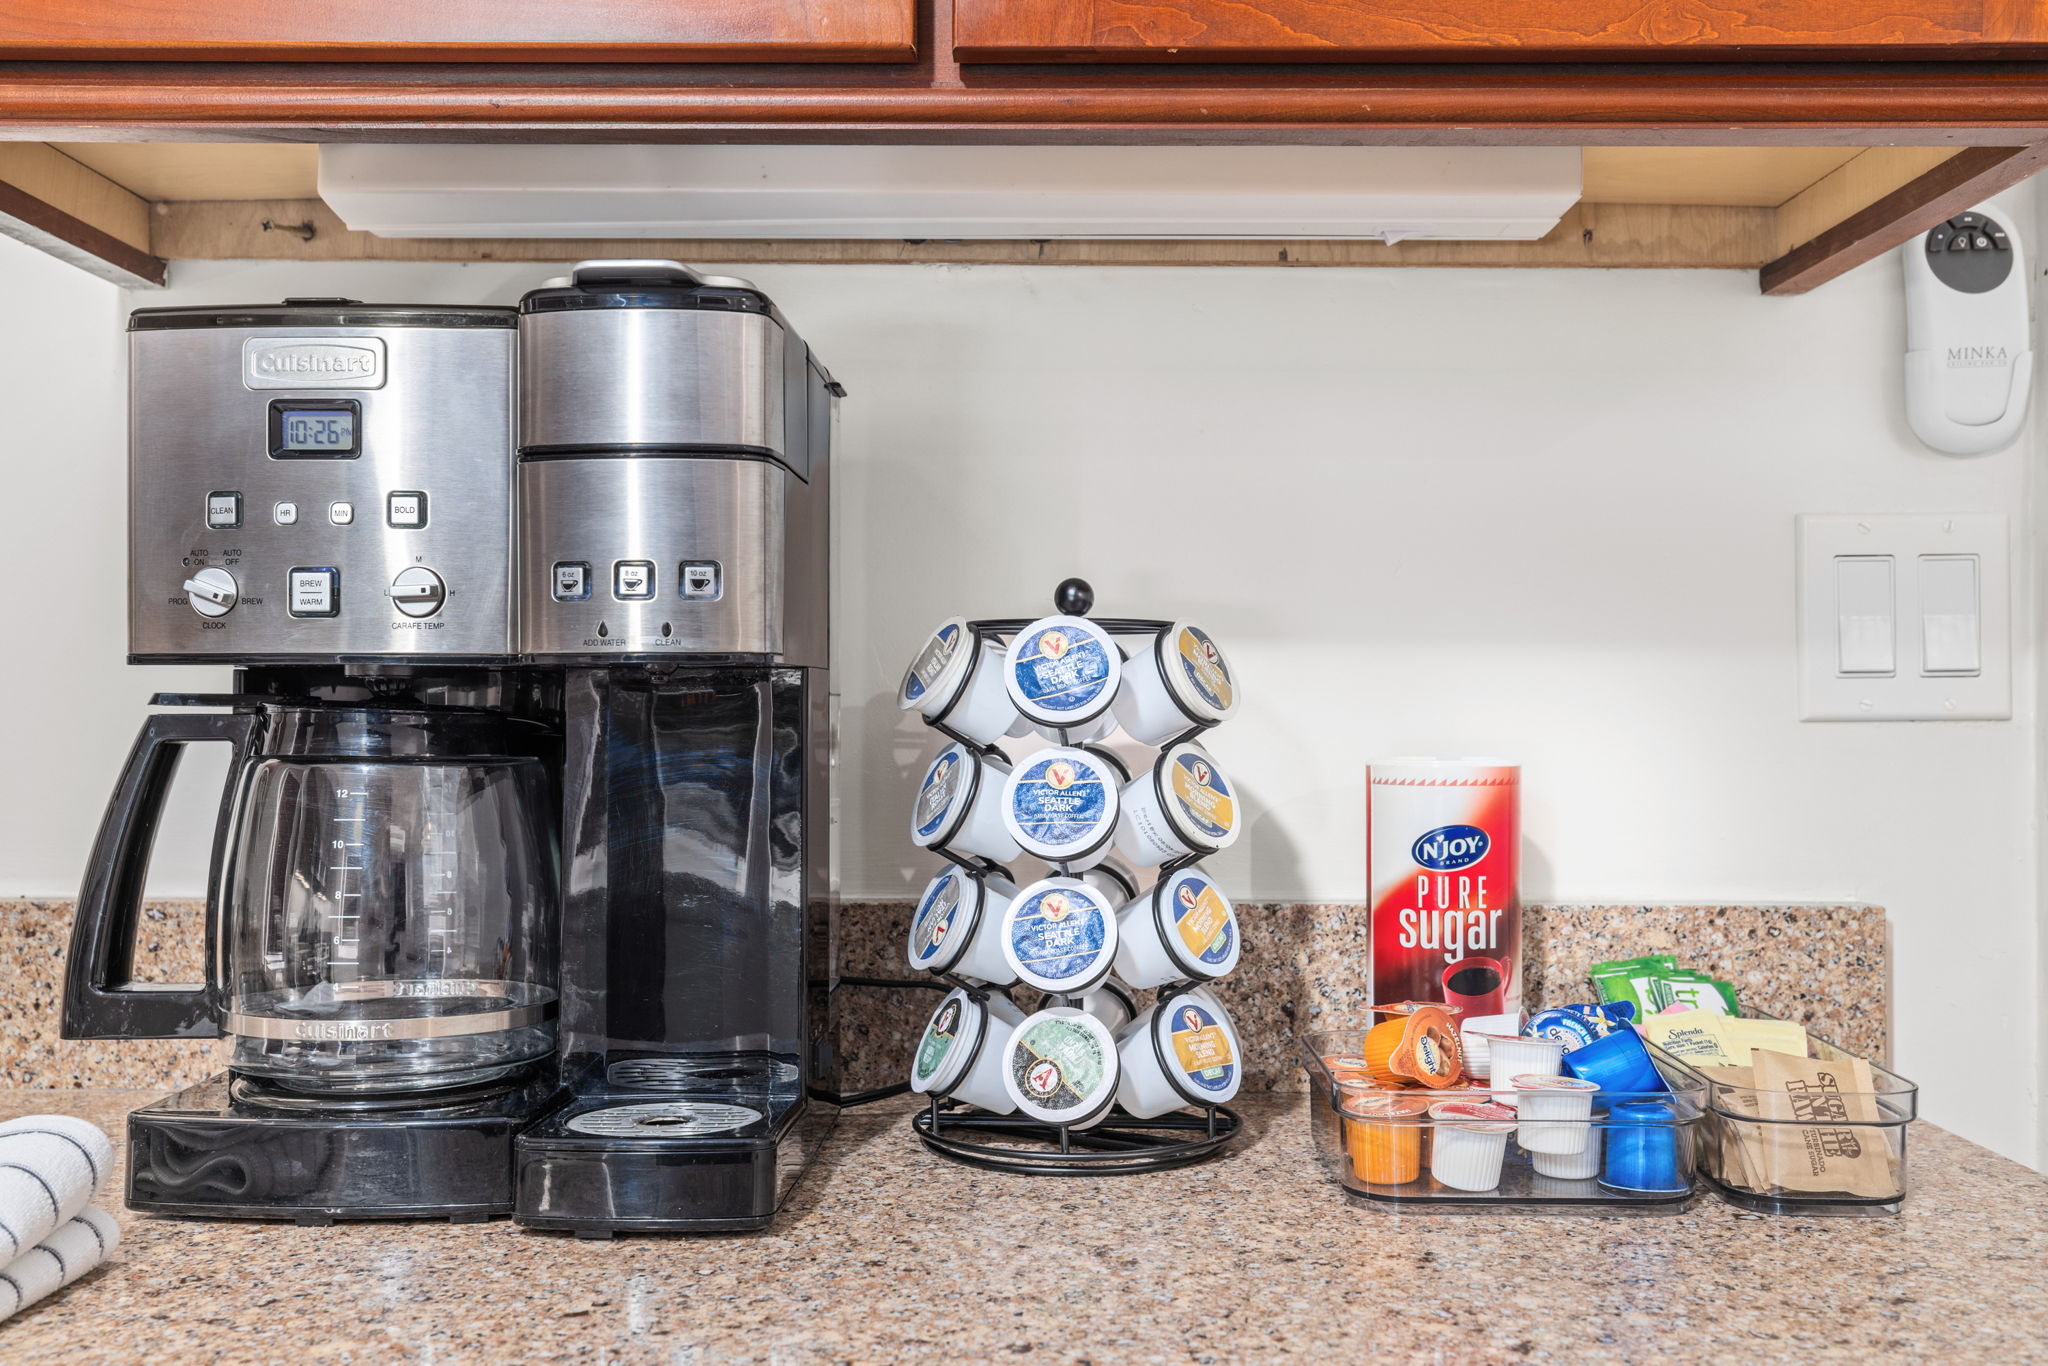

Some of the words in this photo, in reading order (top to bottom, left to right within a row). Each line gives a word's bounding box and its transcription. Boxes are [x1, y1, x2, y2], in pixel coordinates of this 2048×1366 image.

[1947, 346, 2008, 360] MINKA
[259, 353, 370, 373] Cuisinart
[290, 420, 339, 444] 10:26
[211, 507, 234, 515] CLEAN
[279, 509, 292, 517] HR
[394, 506, 416, 514] BOLD
[190, 549, 209, 557] AUTO
[222, 549, 242, 557] AUTO
[193, 558, 205, 566] ON
[225, 558, 240, 566] OFF
[299, 580, 323, 588] BREW
[168, 597, 188, 605] PROG
[241, 597, 264, 605] BREW
[299, 598, 323, 606] WARM
[391, 622, 422, 630] CARAFE
[423, 622, 445, 630] TEMP
[582, 638, 599, 647] ADD
[600, 638, 626, 647] WATER
[655, 638, 682, 647] CLEAN
[1039, 661, 1084, 679] SEATTLE
[1050, 670, 1079, 685] DARK
[336, 789, 349, 798] 12
[1033, 789, 1059, 797] VICTOR
[1038, 796, 1082, 806] SEATTLE
[1044, 804, 1074, 813] DARK
[332, 840, 345, 849] 10
[1439, 857, 1470, 866] BRAND
[334, 891, 342, 899] 8
[1417, 875, 1488, 909] PURE
[1031, 922, 1058, 933] VICTOR
[1038, 927, 1081, 941] SEATTLE
[1399, 908, 1503, 965] sugar
[334, 936, 340, 944] 6
[1045, 936, 1076, 948] DARK
[295, 1021, 393, 1040] Cuisinart
[1668, 1027, 1703, 1040] Splenda
[1446, 1022, 1464, 1064] HAZELNUT
[1420, 1036, 1437, 1075] Delight
[1802, 1129, 1813, 1150] CANE
[1809, 1129, 1826, 1172] TURBINADO
[1807, 1150, 1820, 1177] SUGAR
